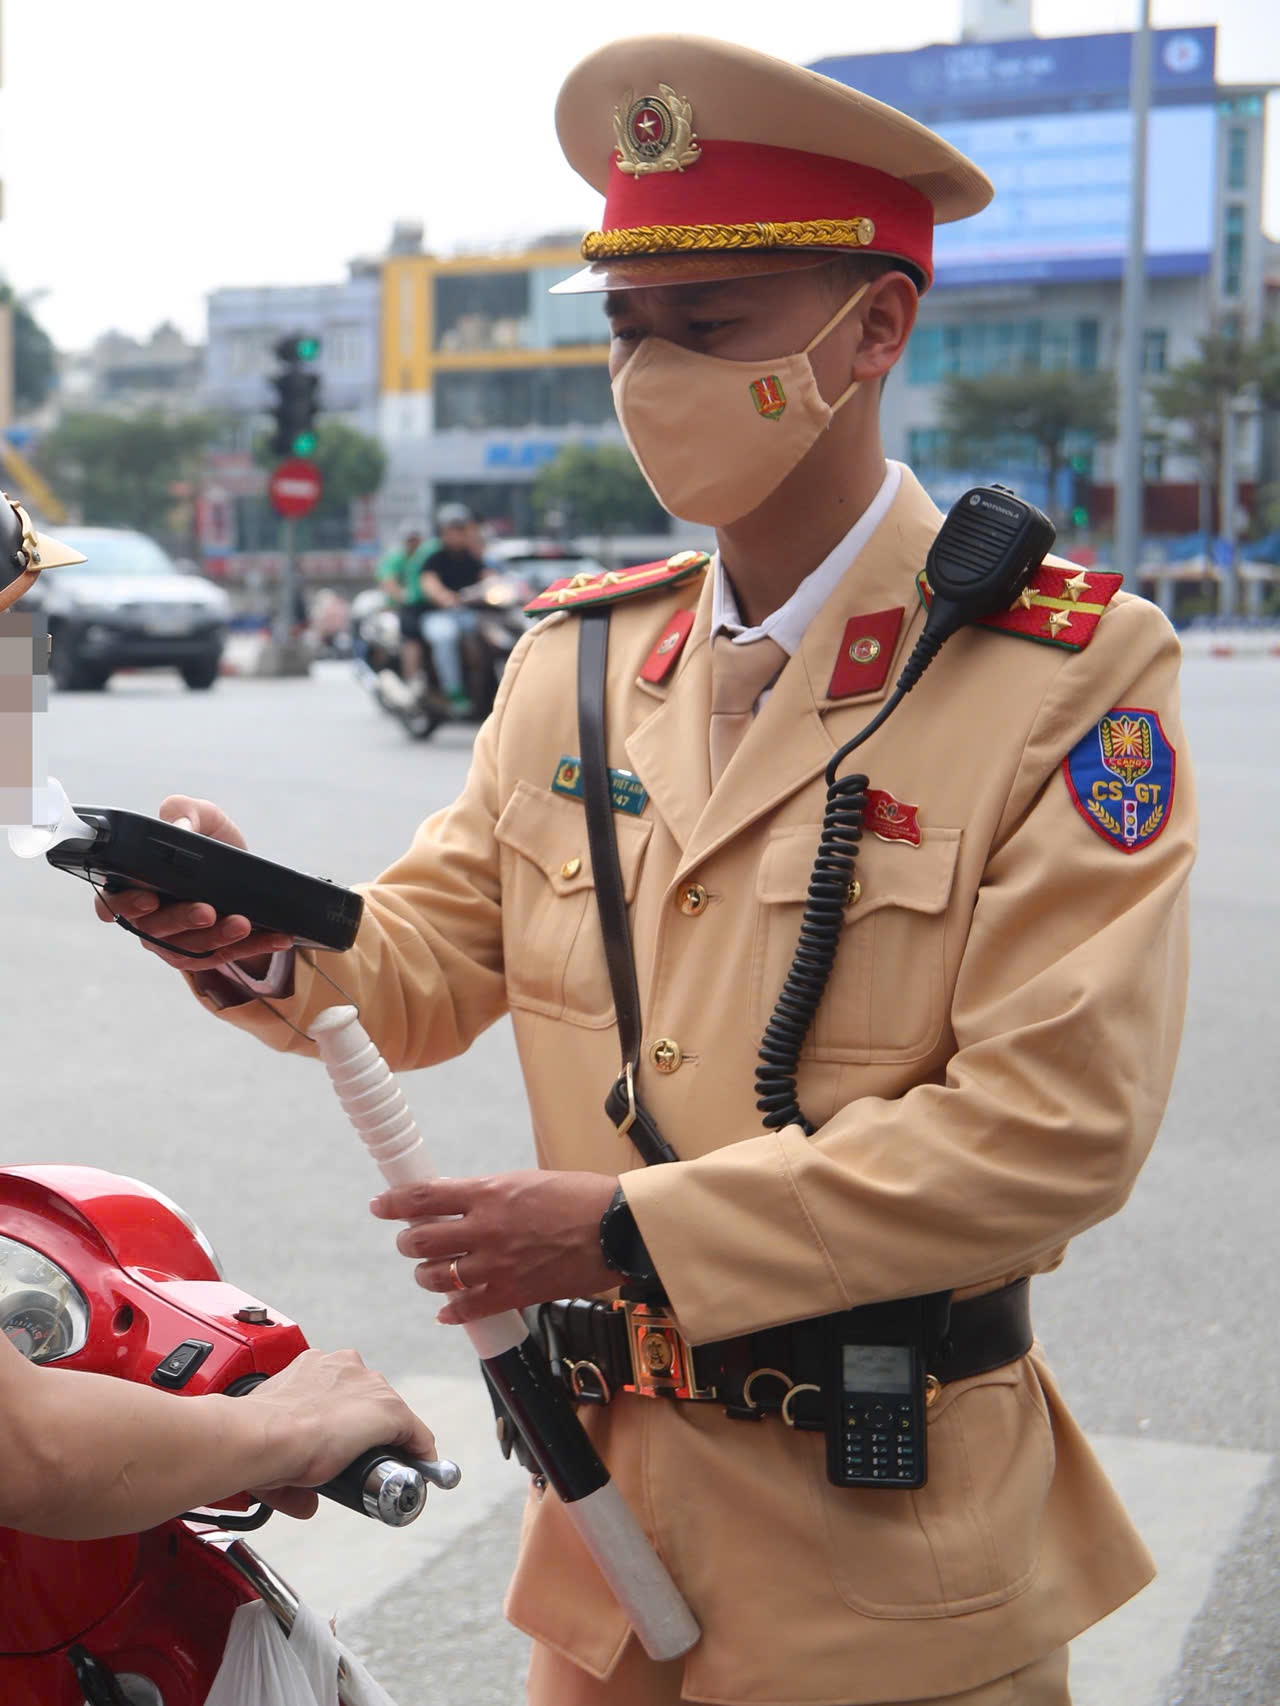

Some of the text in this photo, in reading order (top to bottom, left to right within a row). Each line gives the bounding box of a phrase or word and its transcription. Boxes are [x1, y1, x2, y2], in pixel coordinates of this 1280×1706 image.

[981, 500, 1020, 519] MOTOROLA
[1092, 780, 1161, 804] CS GT
